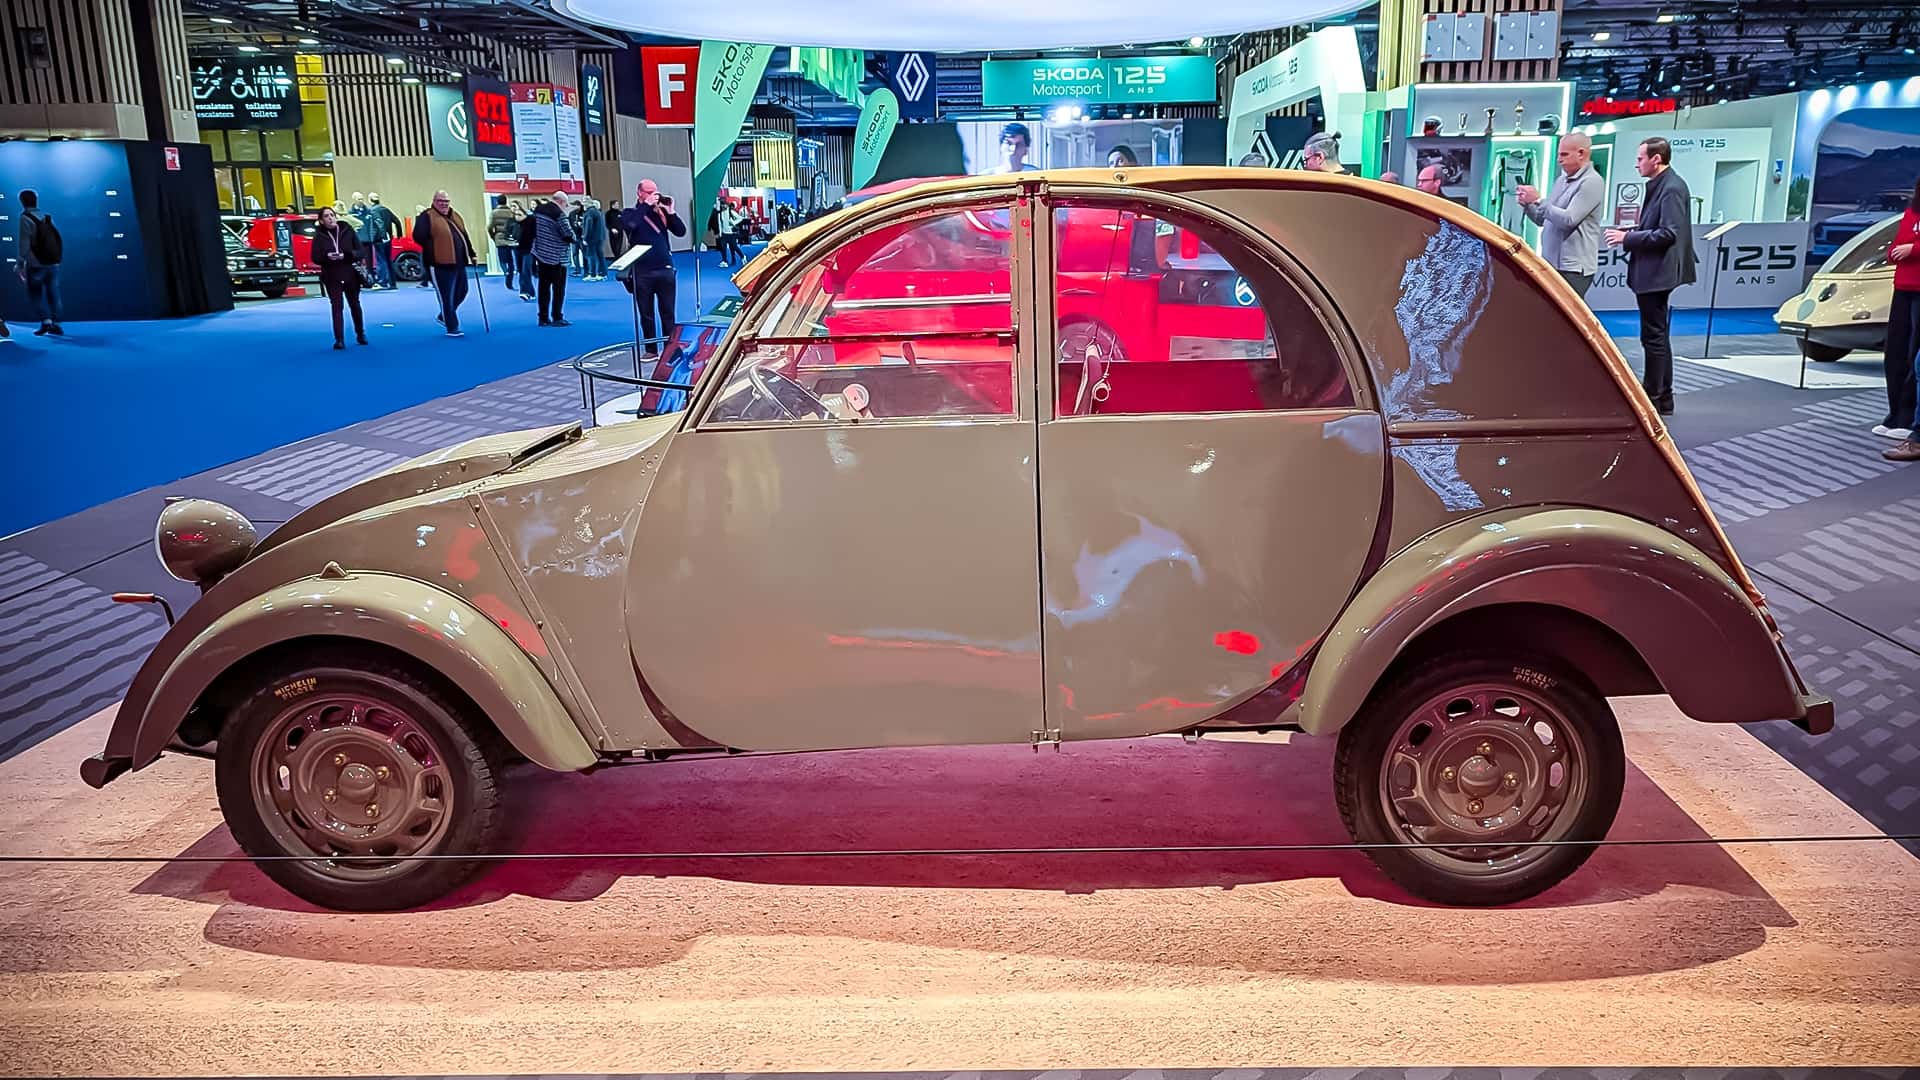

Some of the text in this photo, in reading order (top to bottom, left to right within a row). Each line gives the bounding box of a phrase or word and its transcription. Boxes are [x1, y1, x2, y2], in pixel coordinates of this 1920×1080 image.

[712, 43, 740, 95] SKO
[1113, 65, 1167, 85] 125
[658, 63, 686, 108] F
[1032, 83, 1154, 98] Motorsport ANS
[251, 110, 278, 118] toilets
[1699, 138, 1727, 149] 125
[1716, 245, 1798, 271] 125
[1736, 276, 1776, 285] ANS
[274, 677, 317, 697] MICHELIN
